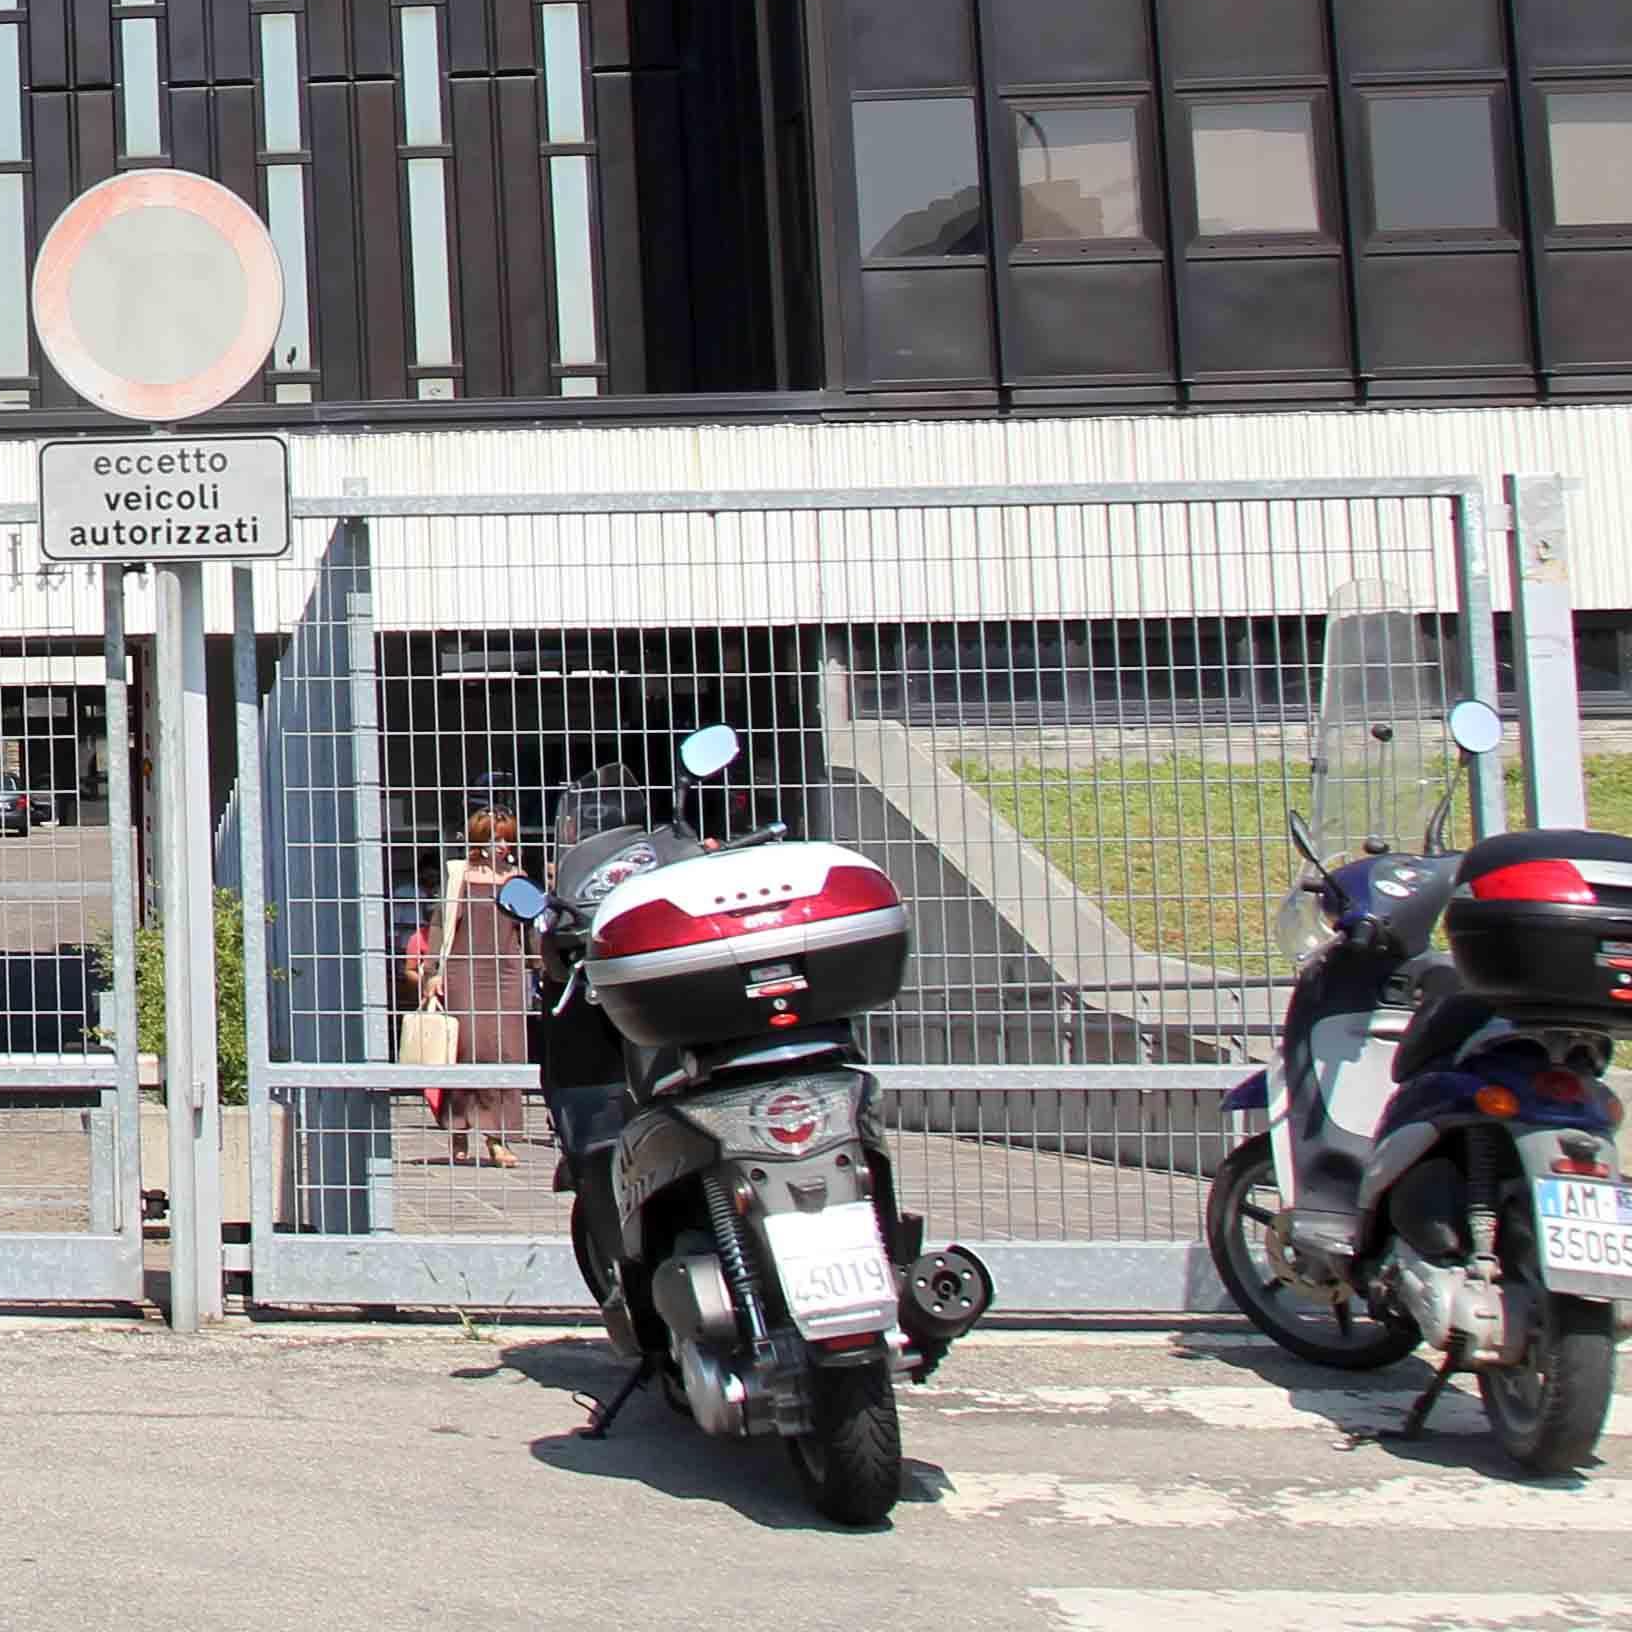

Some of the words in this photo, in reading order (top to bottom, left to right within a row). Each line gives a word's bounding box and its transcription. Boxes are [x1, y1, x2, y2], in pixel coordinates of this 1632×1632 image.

[94, 447, 228, 475] eccetto
[104, 483, 220, 512] veicoli
[69, 516, 259, 547] autorizzati
